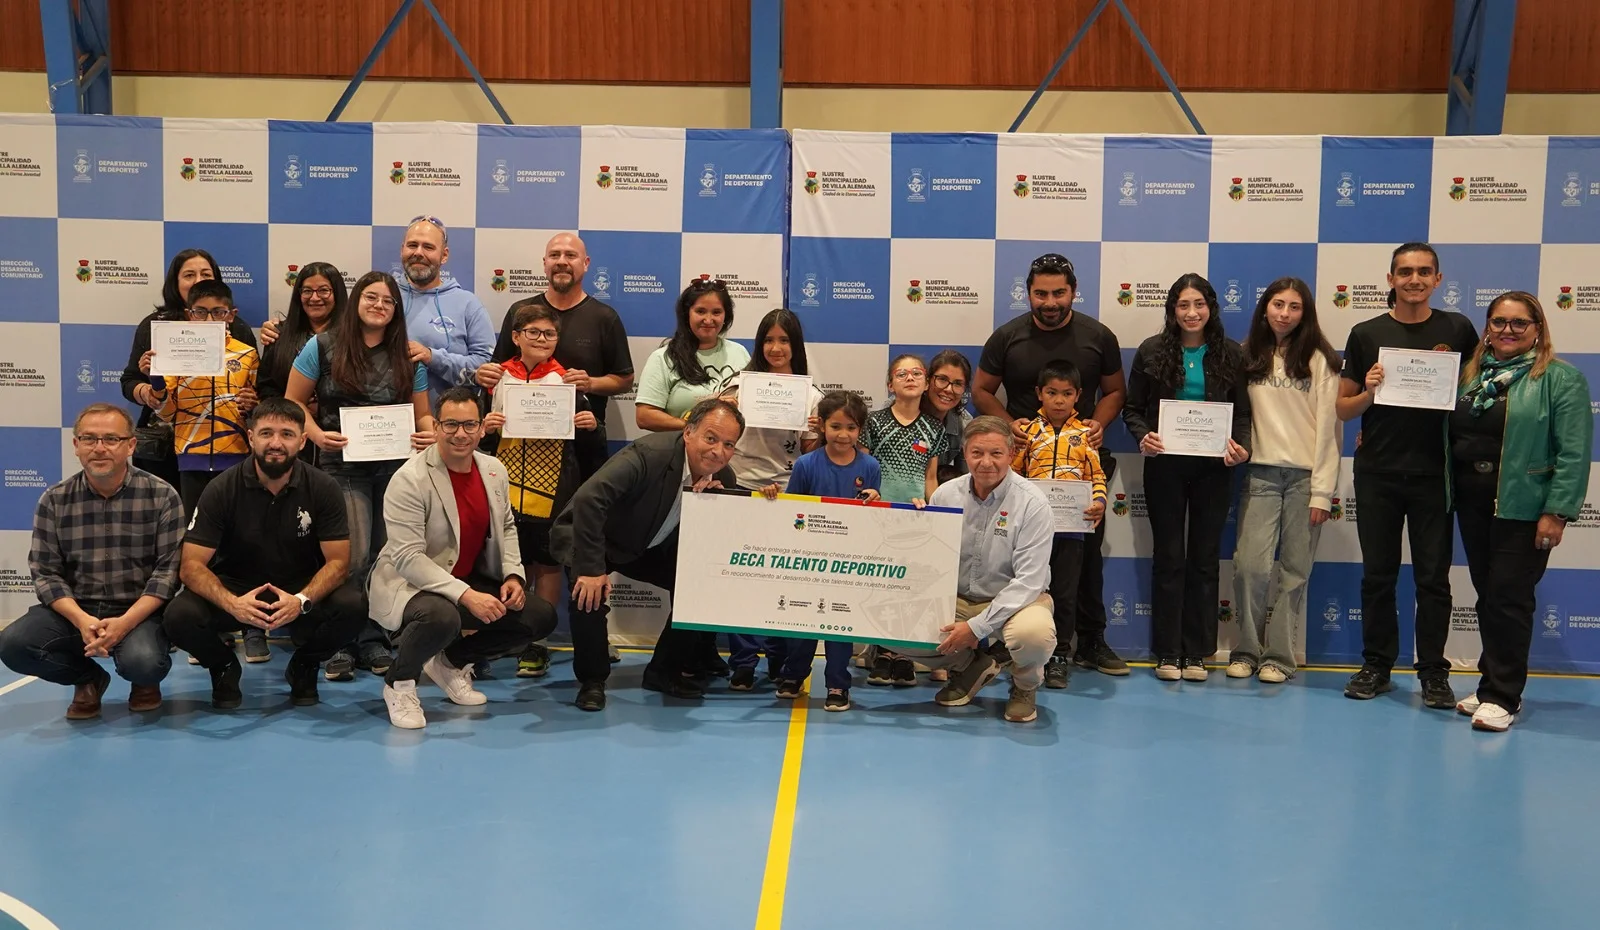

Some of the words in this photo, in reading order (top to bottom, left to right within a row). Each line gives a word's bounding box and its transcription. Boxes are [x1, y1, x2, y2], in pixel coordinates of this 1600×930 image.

[98, 160, 148, 168] DEPARTAMENTO
[1396, 366, 1438, 374] DIPLOMA
[756, 388, 793, 396] DIPLOMA
[358, 421, 397, 429] DIPLOMA
[730, 552, 765, 567] BECA
[770, 555, 828, 572] TALENTO
[830, 560, 907, 579] DEPORTIVO
[731, 570, 774, 579] reconocimiento
